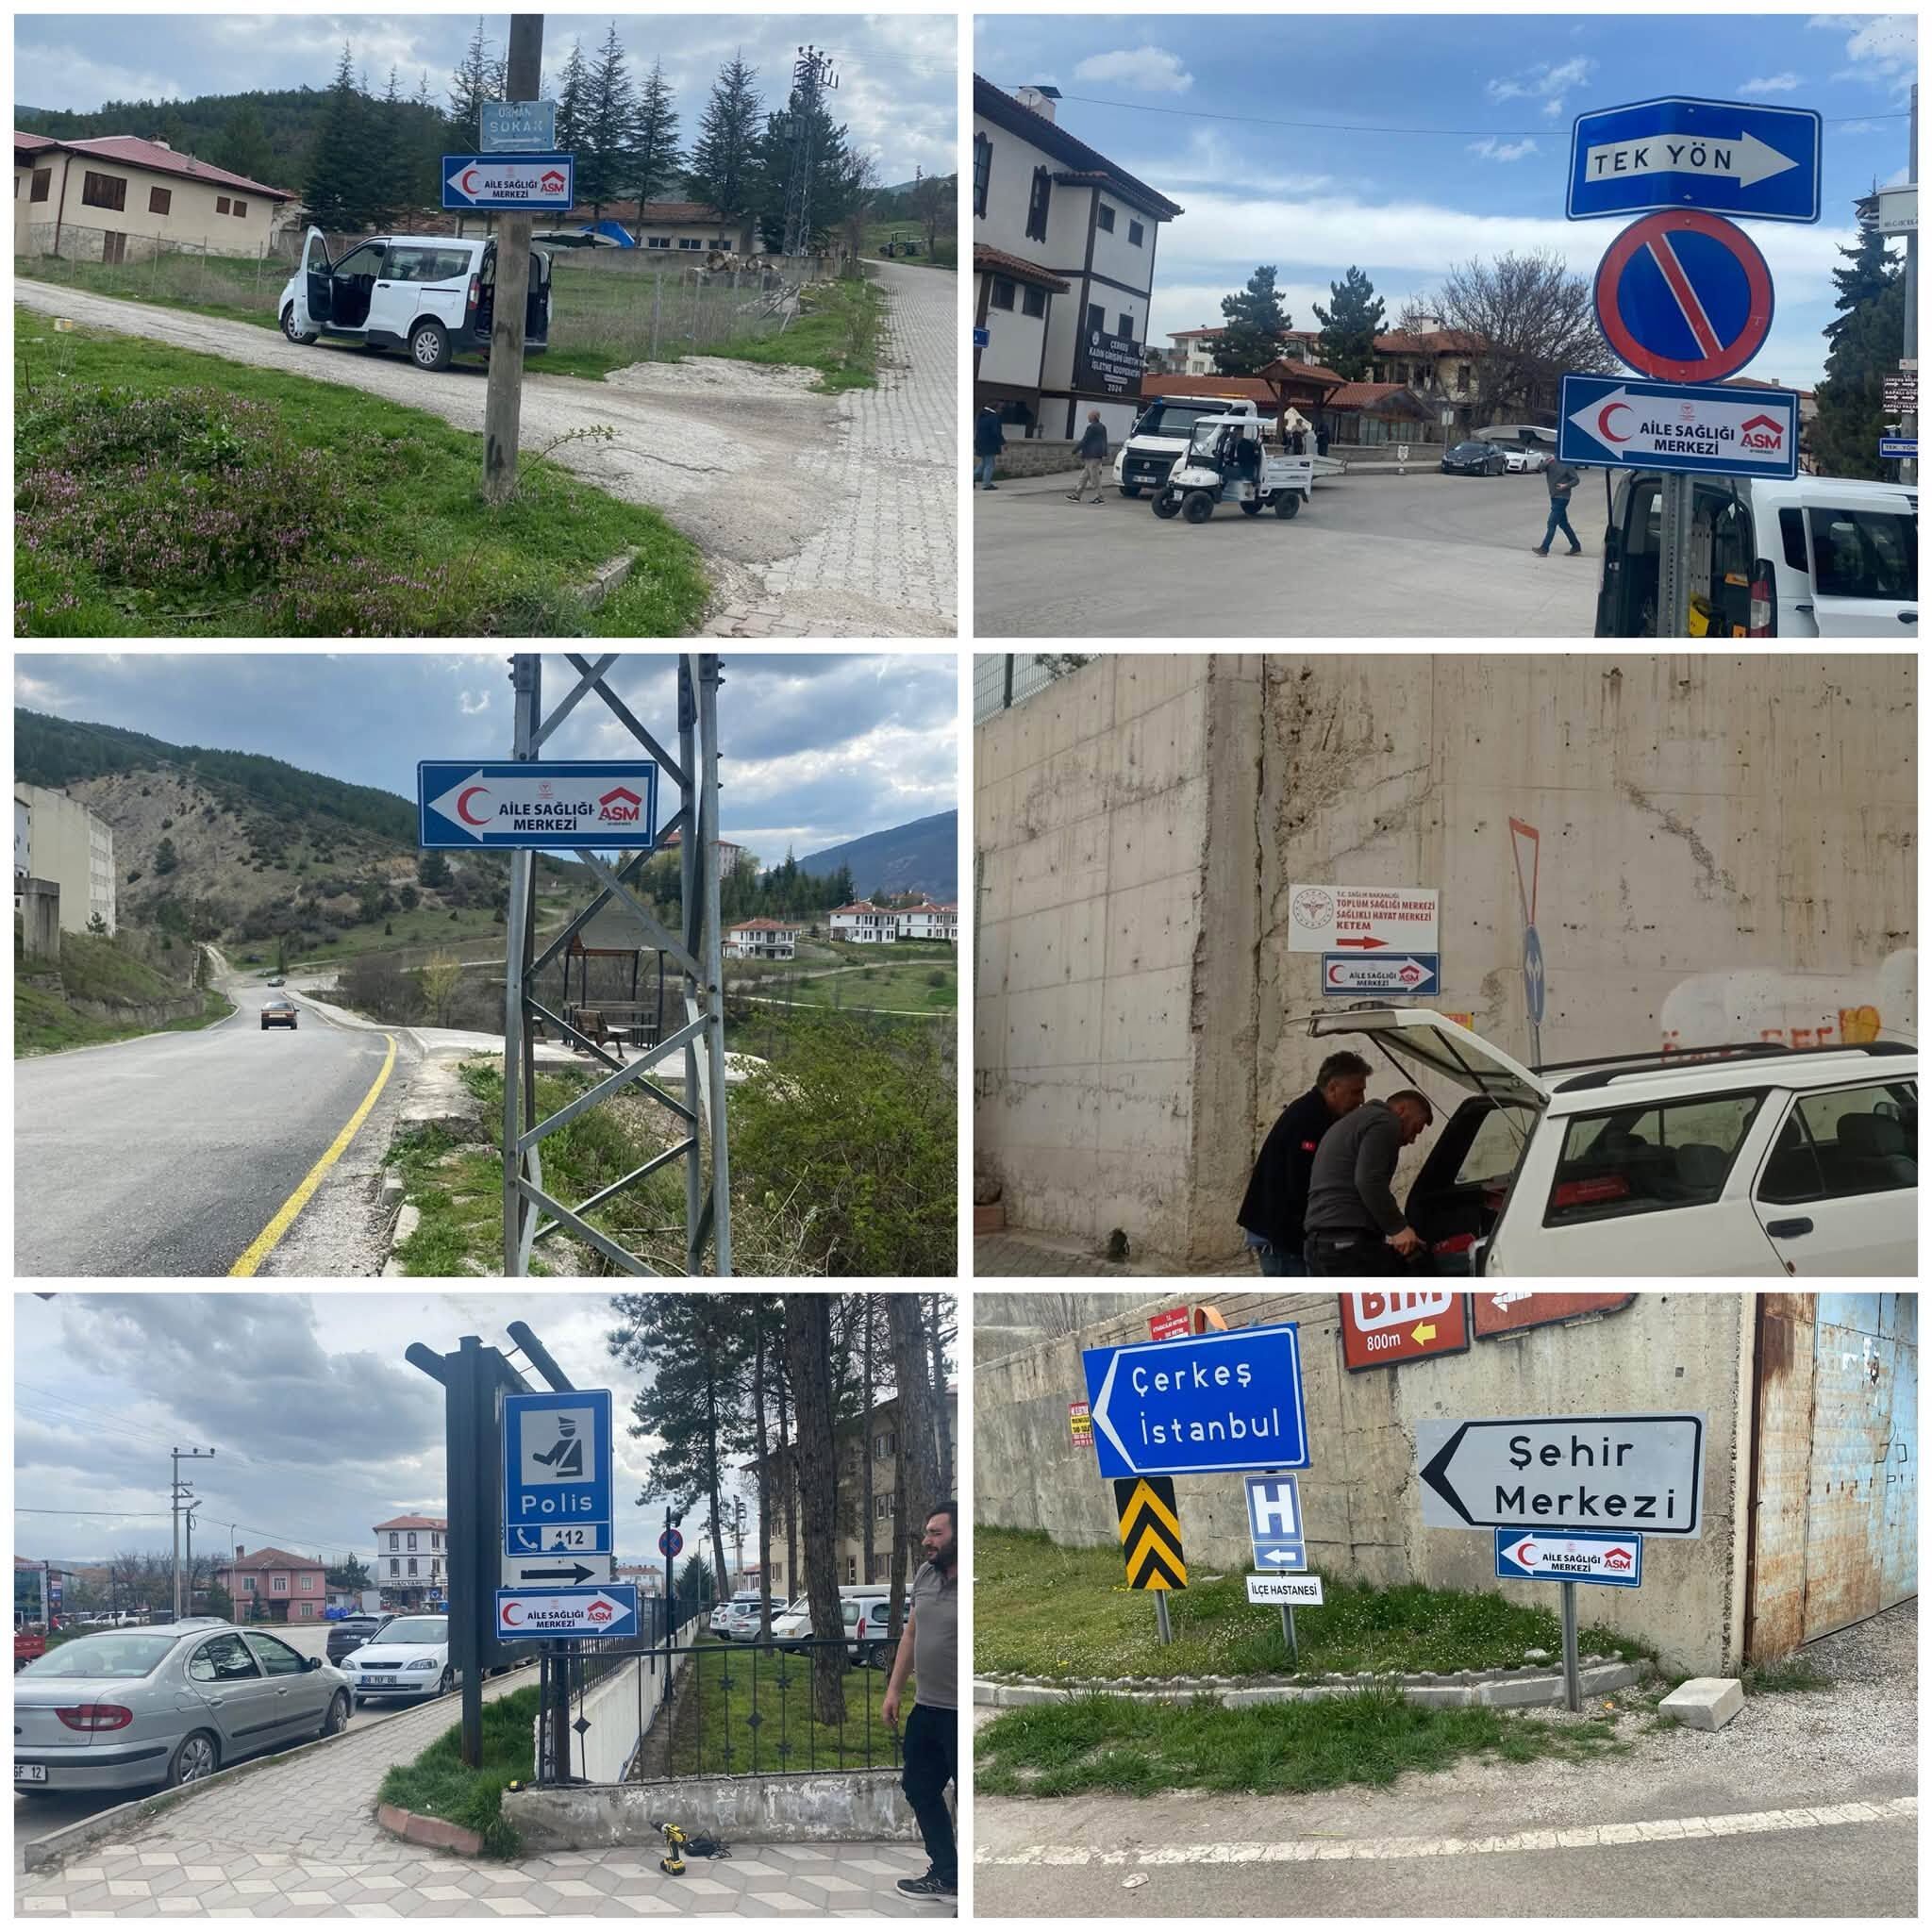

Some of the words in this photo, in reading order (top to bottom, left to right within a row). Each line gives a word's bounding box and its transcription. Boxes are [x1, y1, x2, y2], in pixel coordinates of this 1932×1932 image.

[498, 106, 531, 118] ORMAN
[490, 120, 543, 133] SOKAK
[1594, 147, 1649, 175] TEK
[1666, 142, 1731, 170] YÖN
[484, 179, 503, 189] AİLE
[504, 179, 538, 190] SAĞLIĞI
[540, 183, 564, 192] ASM
[492, 190, 529, 198] MERKEZİ
[1640, 420, 1672, 436] AİLE
[1674, 424, 1735, 441] SAĞLIĞI
[1654, 439, 1719, 456] MERKEZİ
[1740, 433, 1782, 450] ASM
[499, 801, 530, 815] AİLE
[534, 801, 594, 816] SAĞLIĞI
[598, 807, 640, 821] ASM
[514, 817, 576, 830] MERKEZİ
[1337, 899, 1369, 908] TOPLUM
[1370, 899, 1401, 909] SAĞLIĞI
[1402, 901, 1435, 910] MERKEZİ
[1336, 909, 1371, 920] SAĞLIKLI
[1373, 911, 1396, 920] HAYAT
[1398, 912, 1431, 921] MERKEZİ
[1336, 921, 1371, 930] KETEM
[1349, 971, 1365, 979] AİLE
[1367, 971, 1396, 979] SAĞLIĞI
[1398, 973, 1420, 982] ASM
[1367, 1332, 1401, 1351] 800m
[1132, 1361, 1252, 1397] Çerkeş
[1141, 1407, 1279, 1445] İstanbul
[1508, 1435, 1634, 1471] Şehir
[522, 1492, 592, 1515] Polis
[1495, 1485, 1674, 1519] Merkezi
[1252, 1484, 1295, 1535] H
[1542, 1552, 1562, 1562] AİLE
[1564, 1554, 1601, 1564] SAĞLIĞI
[1604, 1559, 1631, 1570] ASM
[1551, 1563, 1591, 1573] MERKEZİ
[1251, 1582, 1269, 1597] İLÇE
[1270, 1583, 1317, 1596] HASTANESİ
[527, 1610, 547, 1620] AİLE
[548, 1610, 584, 1620] SAĞLIĞI
[587, 1611, 612, 1621] ASM
[536, 1620, 575, 1628] MERKEZİ
[31, 1765, 42, 1778] 12
